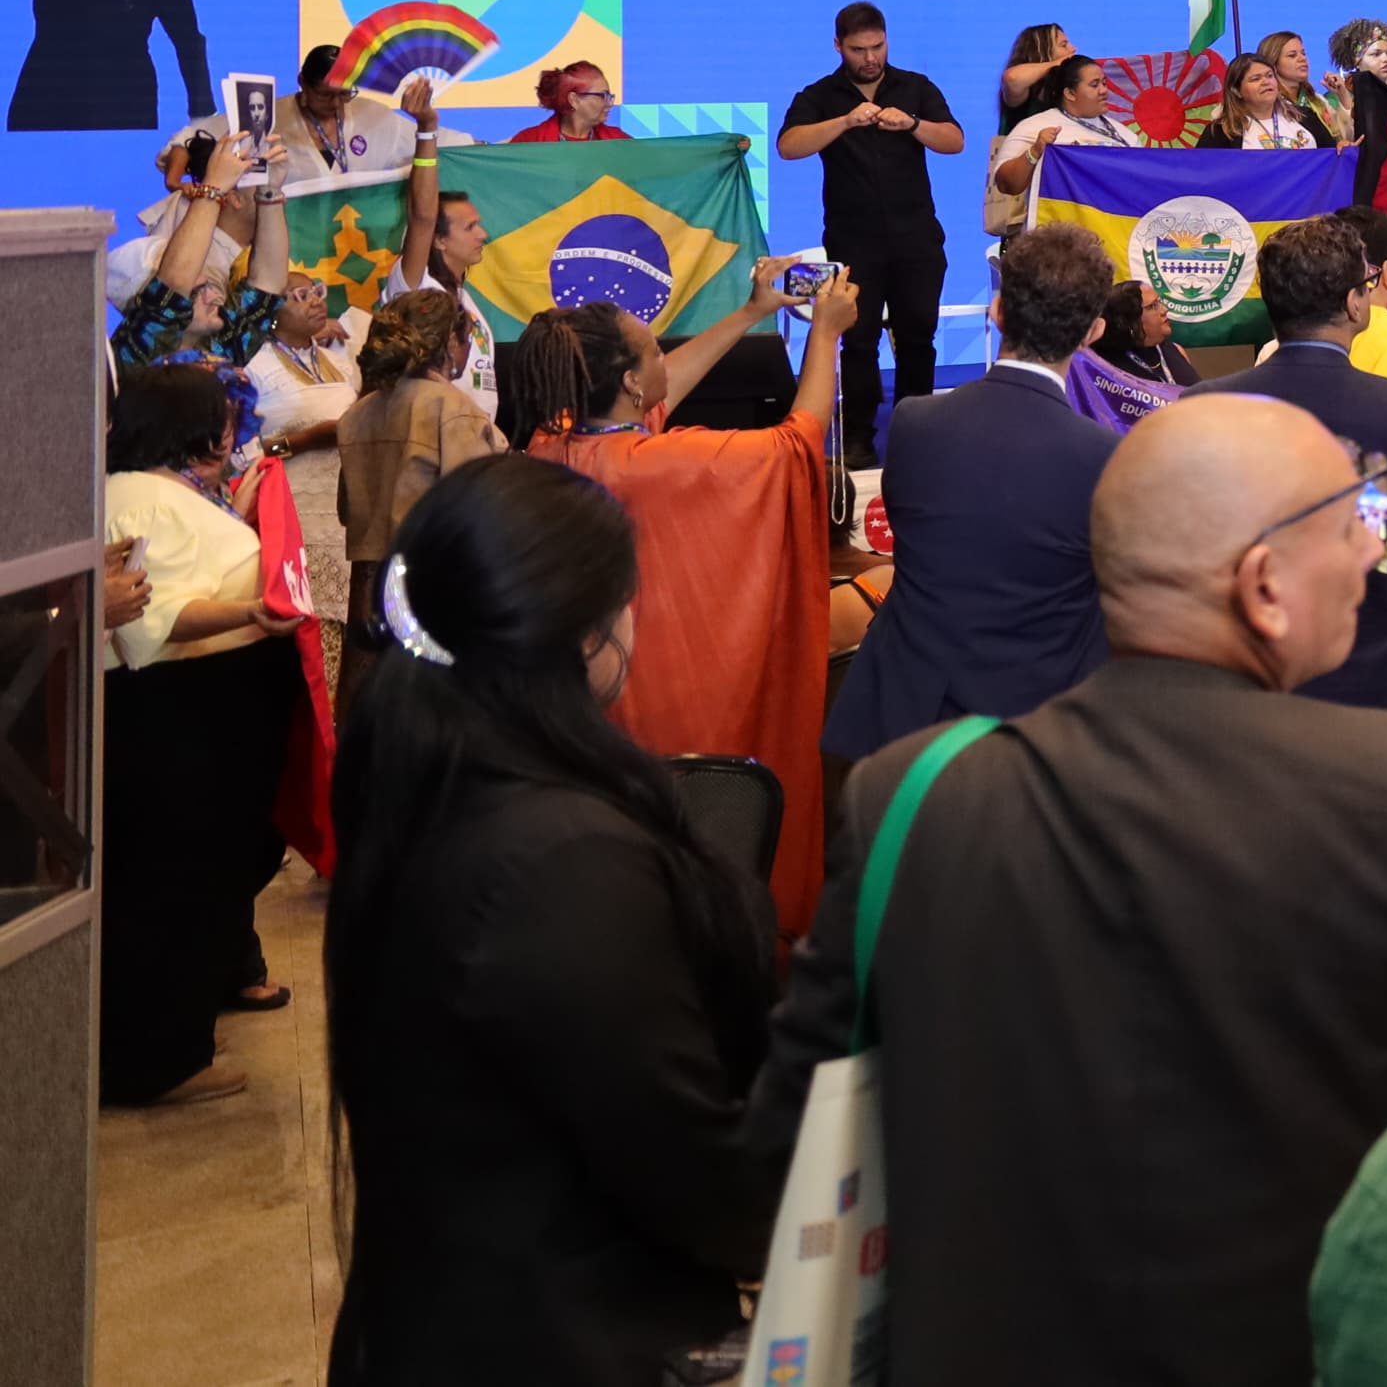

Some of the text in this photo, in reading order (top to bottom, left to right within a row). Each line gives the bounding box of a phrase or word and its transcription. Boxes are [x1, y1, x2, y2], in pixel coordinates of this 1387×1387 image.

[555, 249, 596, 259] ORDEM
[616, 253, 673, 286] PROGRESSO
[1094, 375, 1151, 404] SINDICATO
